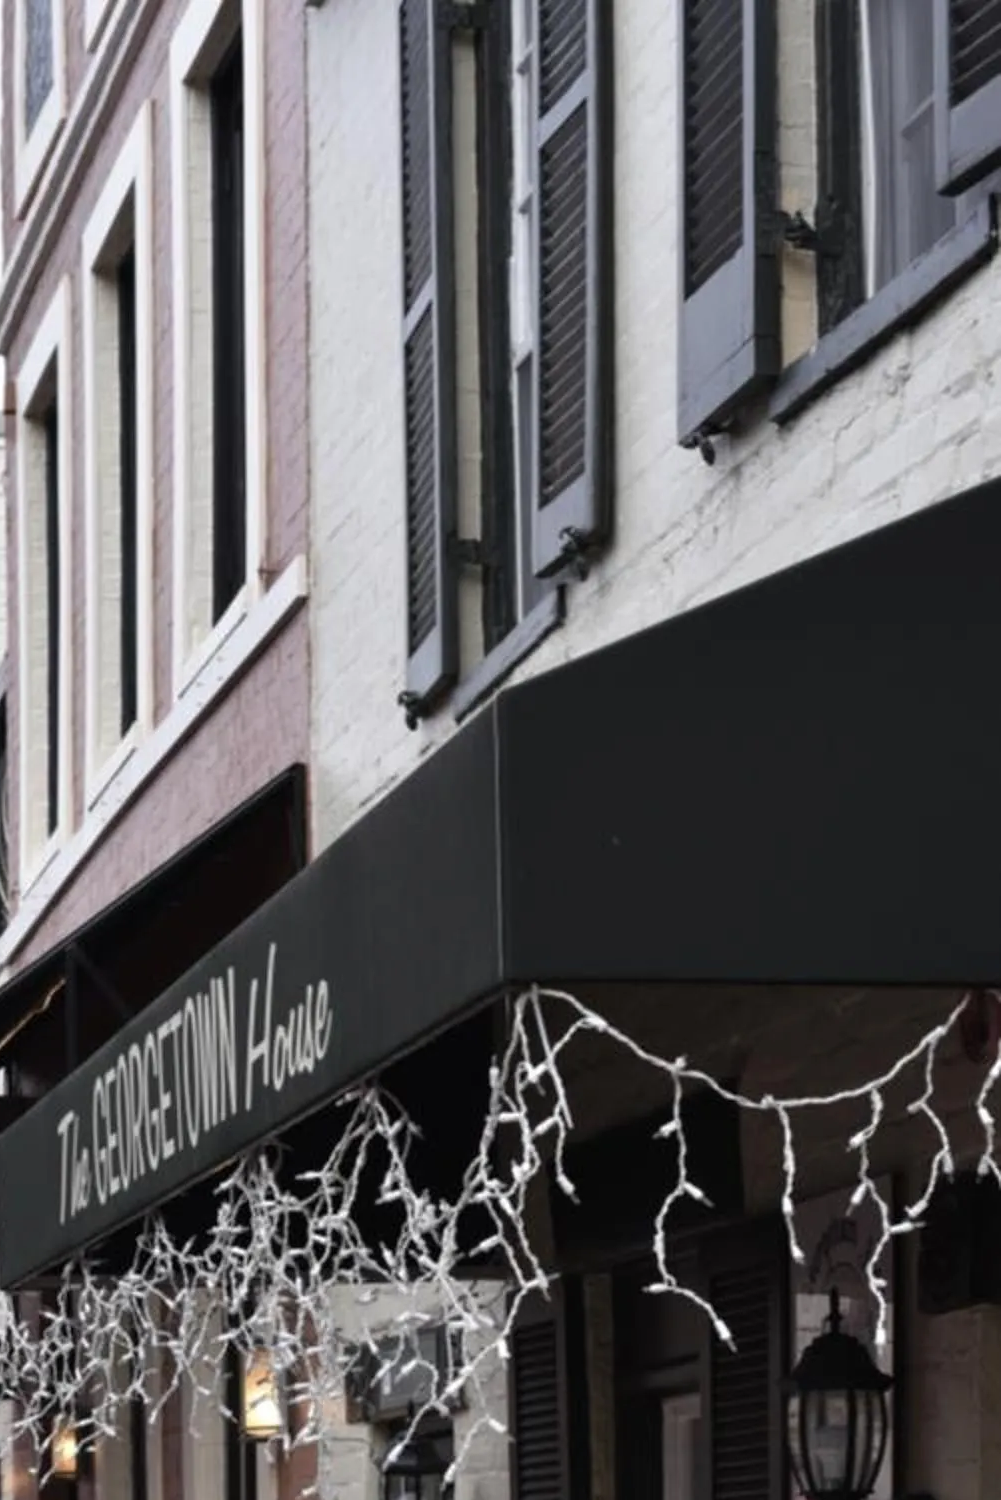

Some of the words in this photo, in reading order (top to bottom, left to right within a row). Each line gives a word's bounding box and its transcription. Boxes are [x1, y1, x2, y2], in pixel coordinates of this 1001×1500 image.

[57, 1109, 92, 1226] The
[92, 966, 237, 1205] GEORGETOWN
[244, 942, 334, 1112] House
